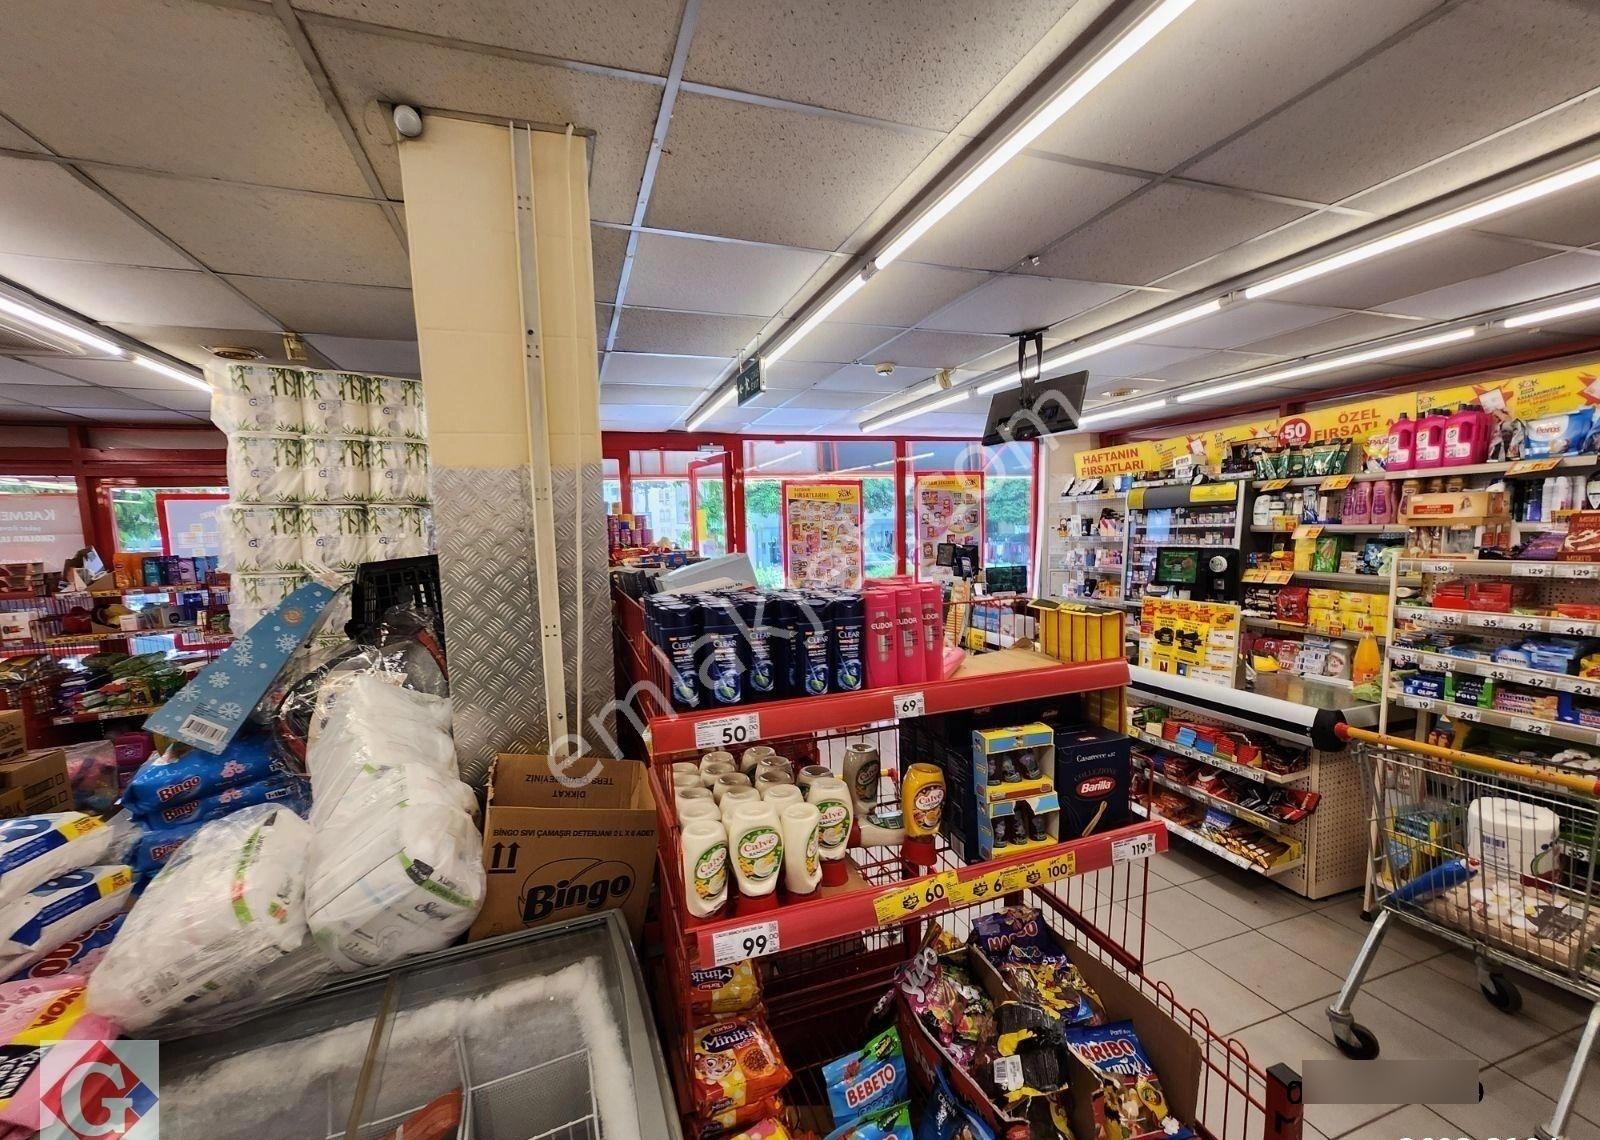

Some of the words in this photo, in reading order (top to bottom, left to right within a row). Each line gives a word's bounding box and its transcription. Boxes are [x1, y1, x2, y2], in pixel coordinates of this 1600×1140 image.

[1338, 408, 1381, 424] ÖZEL
[1082, 447, 1139, 465] HAFTANIN
[1080, 460, 1145, 476] FIRSATLARI
[1442, 615, 1455, 623] 35
[1482, 619, 1497, 627] 35
[1518, 622, 1534, 630] 42
[1566, 627, 1584, 635] 46
[807, 636, 829, 644] CLEAR
[838, 630, 860, 639] CLEAR
[712, 640, 738, 648] CLEAR
[1400, 653, 1412, 662] 33
[1436, 660, 1449, 669] 33
[1490, 671, 1505, 679] 45
[1528, 678, 1544, 687] 47
[1574, 685, 1592, 695] 24
[902, 699, 916, 712] 69
[1460, 711, 1474, 719] 24
[722, 725, 747, 744] 50
[1528, 724, 1543, 734] 22
[157, 775, 202, 803] Bingo
[1080, 779, 1113, 794] Barilla
[551, 789, 587, 799] DİKKAT
[163, 799, 200, 823] Bingo
[1131, 842, 1147, 856] 119
[1047, 863, 1068, 878] 100
[993, 878, 1003, 893] 6
[522, 874, 632, 923] Bingo
[925, 883, 945, 903] 60
[742, 934, 767, 957] 99
[845, 1063, 897, 1109] BEBETO
